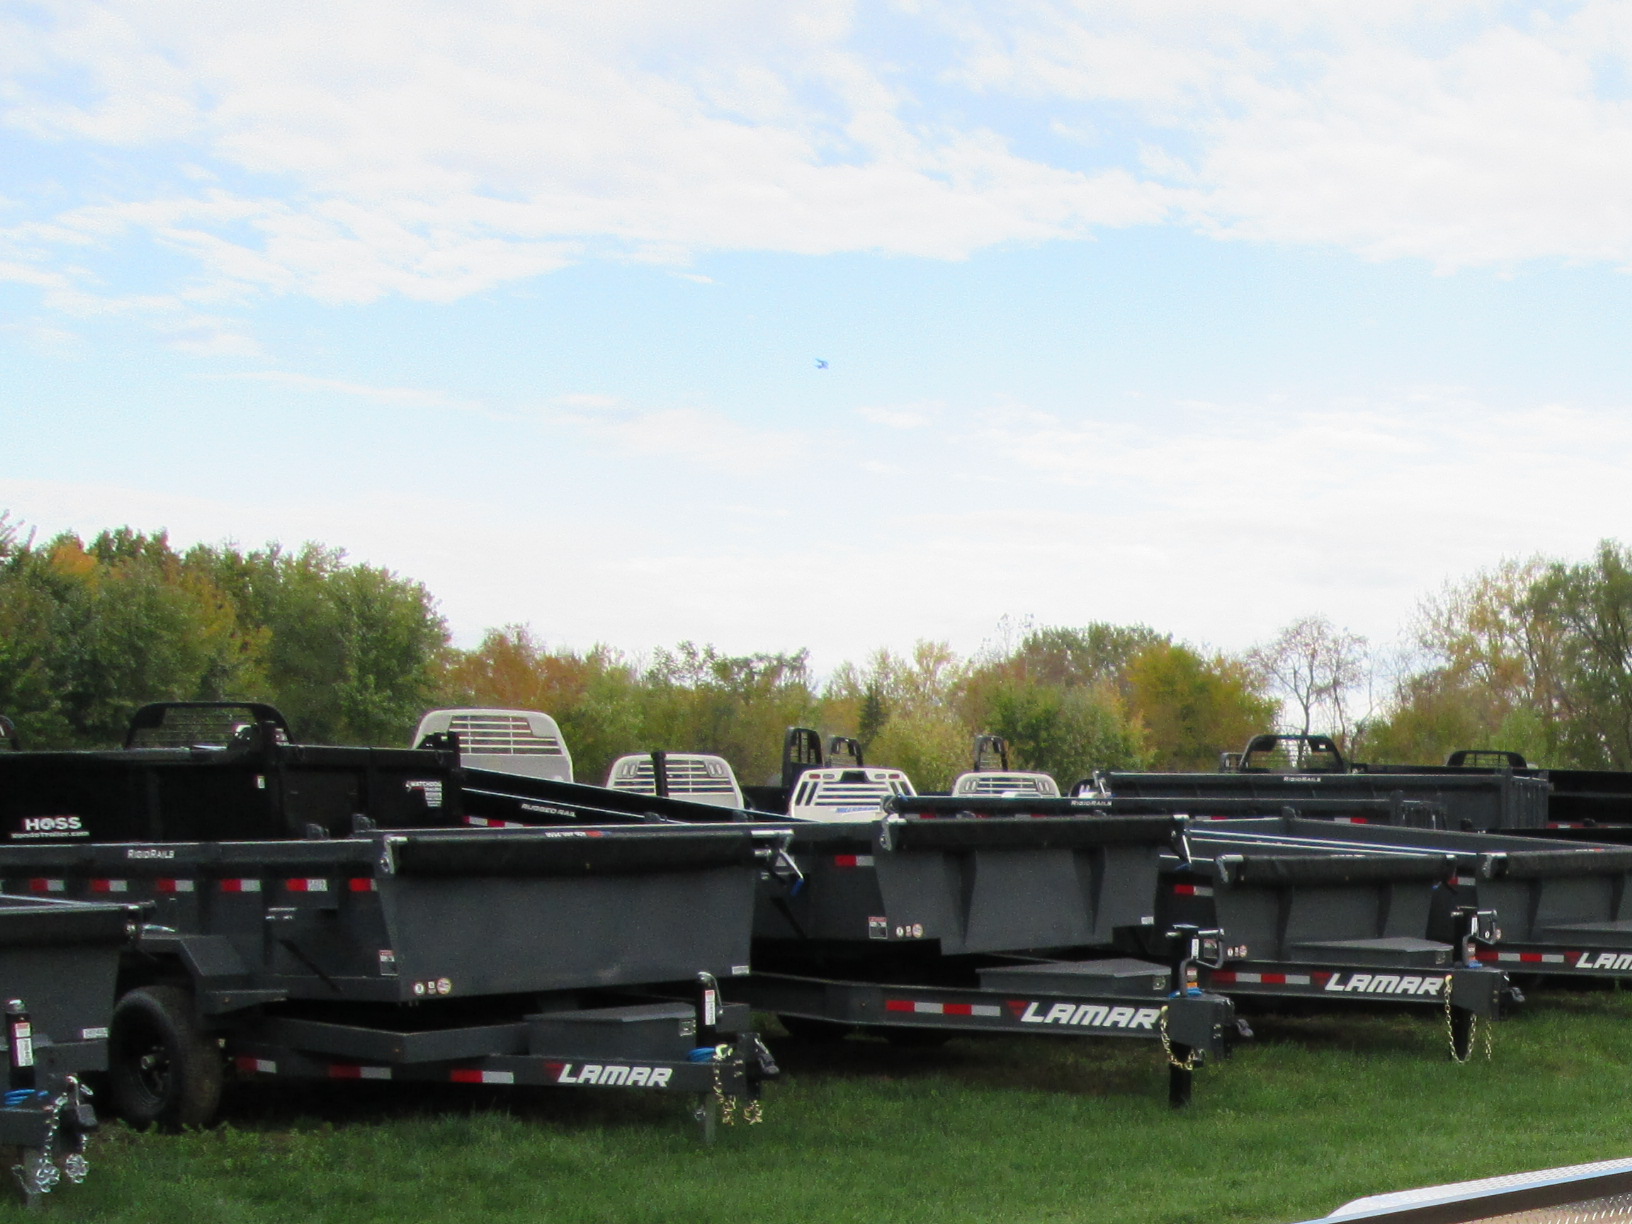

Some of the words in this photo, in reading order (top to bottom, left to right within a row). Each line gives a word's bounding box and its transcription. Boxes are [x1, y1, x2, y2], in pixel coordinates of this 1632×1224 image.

[24, 816, 82, 831] HOSS
[1325, 973, 1444, 996] LAMAR
[1020, 1001, 1161, 1030] LAMAR
[557, 1063, 673, 1087] LAMAR
